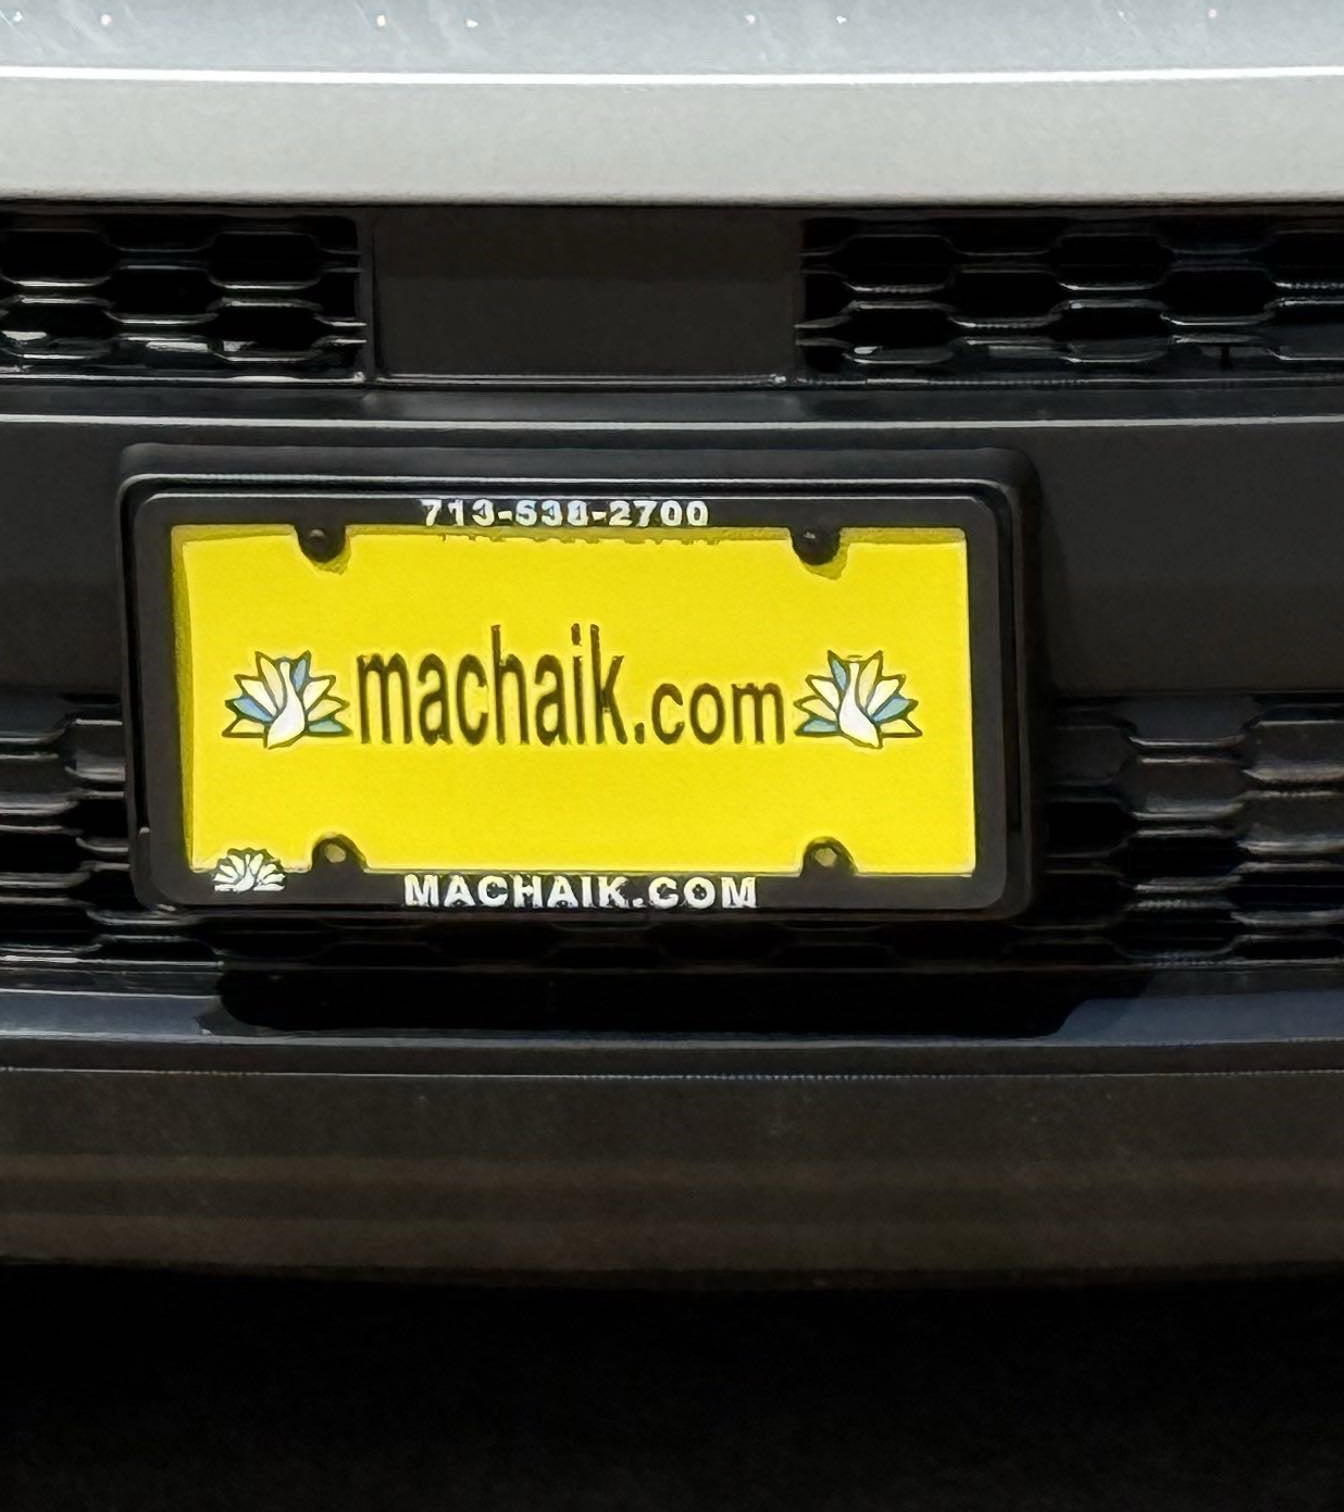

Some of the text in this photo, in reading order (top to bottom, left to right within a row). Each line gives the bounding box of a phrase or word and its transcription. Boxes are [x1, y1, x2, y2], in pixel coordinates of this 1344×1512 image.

[420, 497, 709, 528] 713-538-2700
[355, 622, 786, 746] machaik.com
[402, 873, 757, 909] MACHAIK.COM
